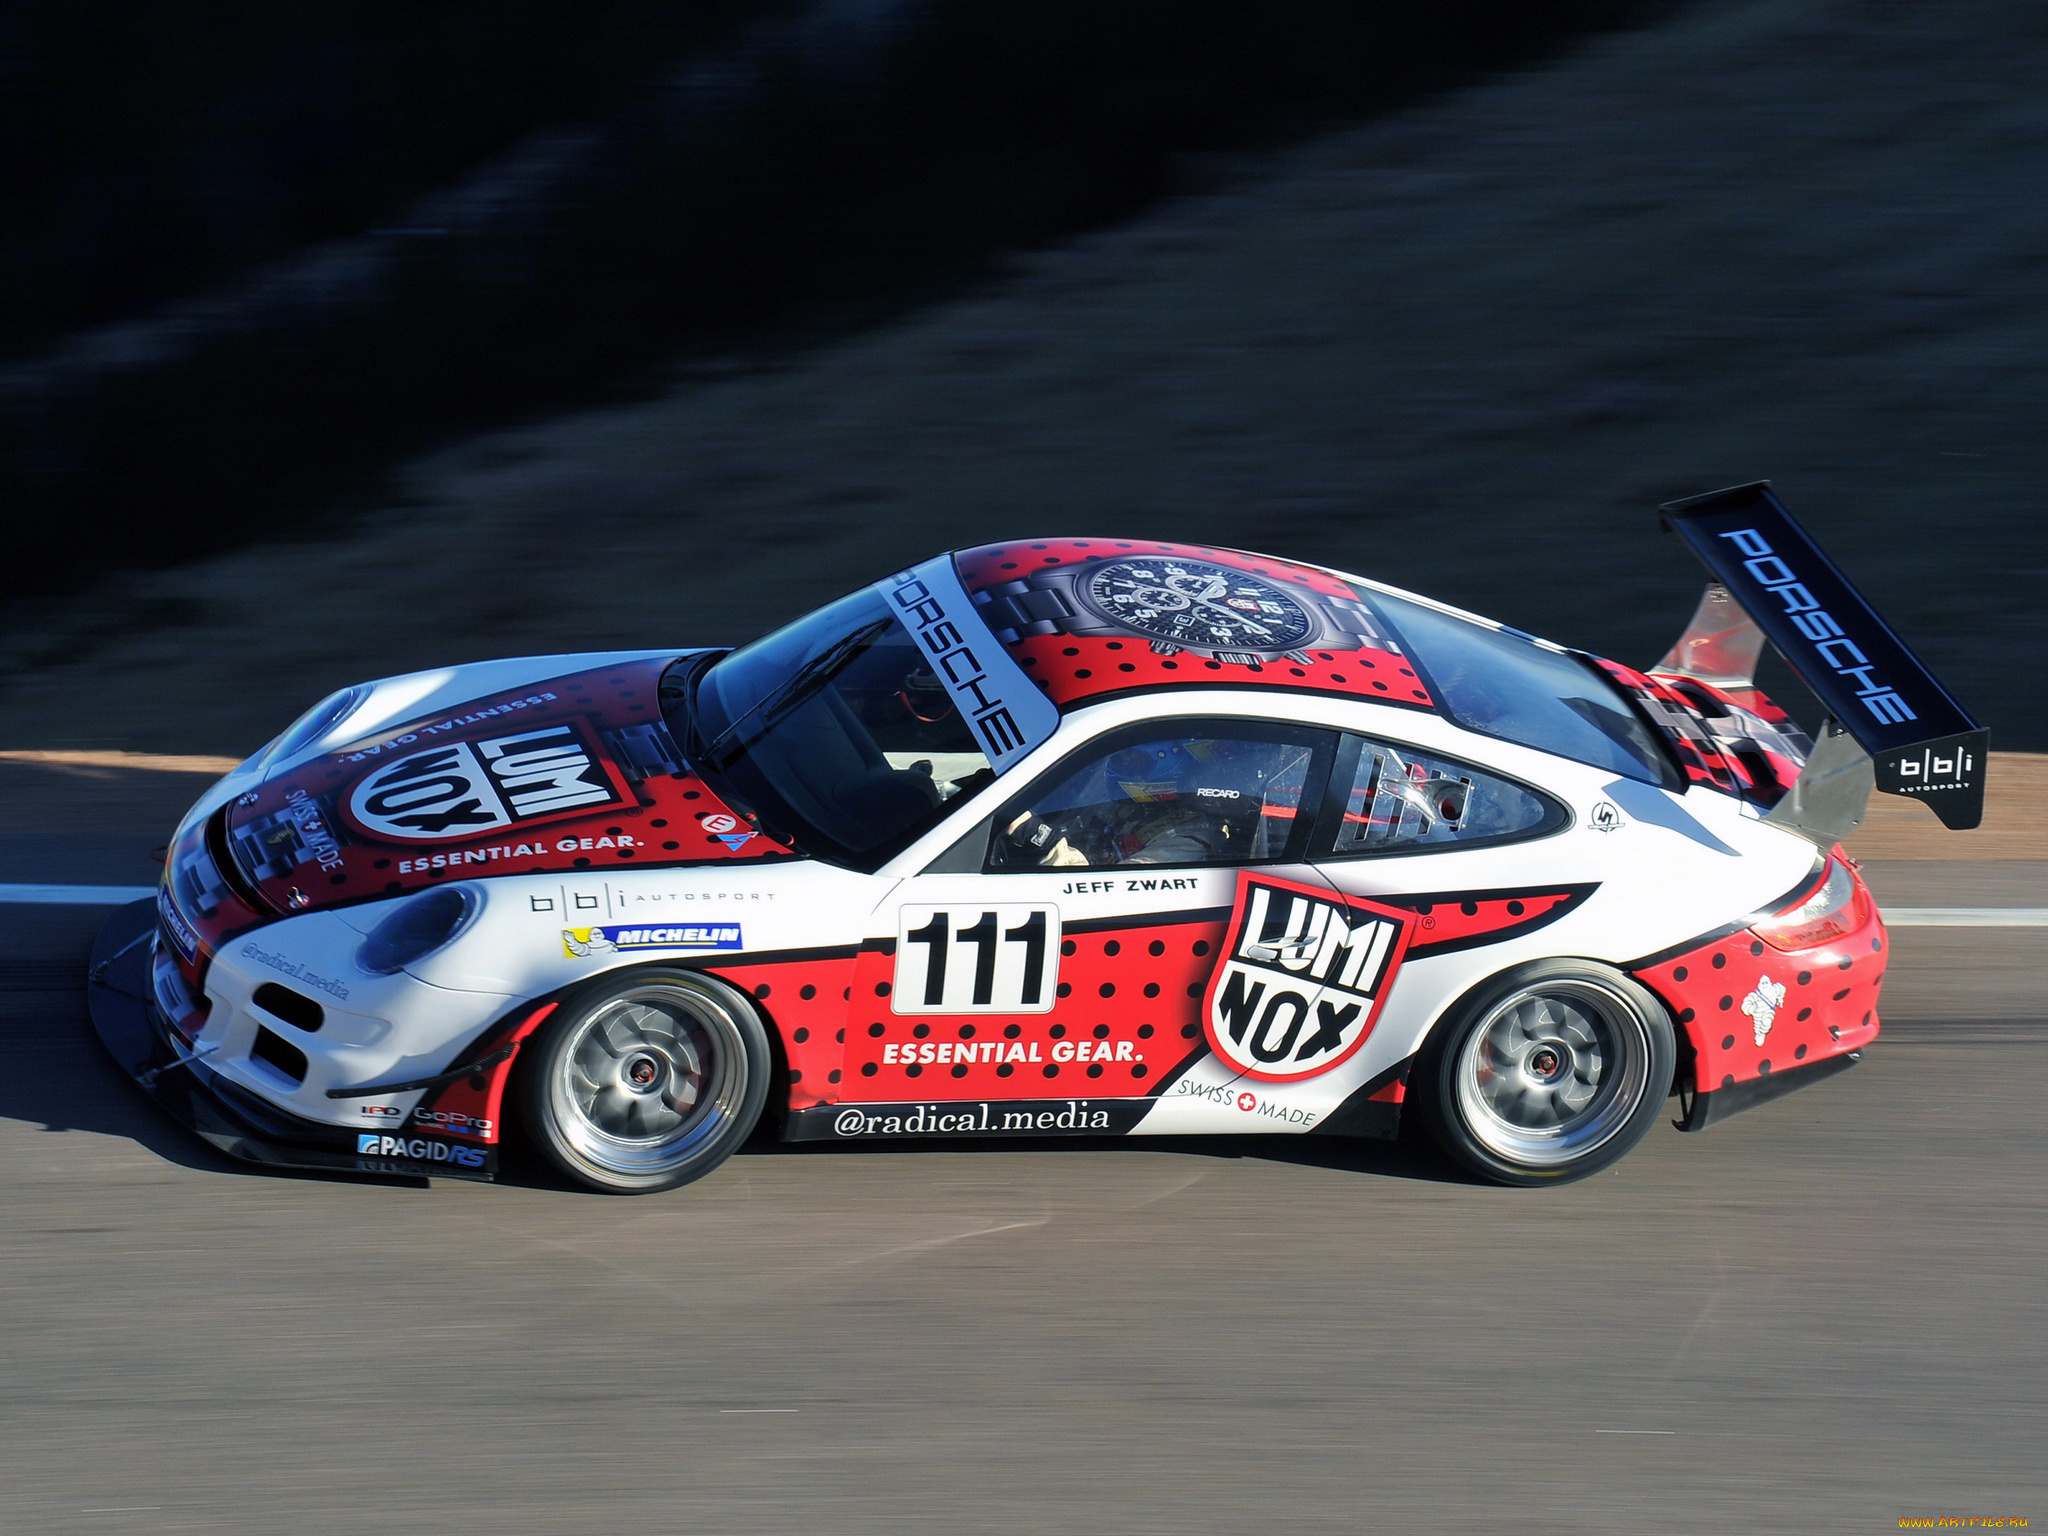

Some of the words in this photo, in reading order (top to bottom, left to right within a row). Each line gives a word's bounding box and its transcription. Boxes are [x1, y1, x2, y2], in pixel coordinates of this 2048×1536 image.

[1718, 528, 1919, 725] PORSCHE
[422, 692, 557, 734] ESSENTIAL
[364, 747, 499, 833] NOX
[477, 725, 612, 817] LUMI
[1899, 782, 1970, 793] AUTOSPORT
[1197, 786, 1240, 799] RECARO
[285, 789, 320, 822] SWISS
[306, 828, 345, 873] MADE
[399, 841, 548, 875] ESSENTIAL
[556, 834, 646, 852] GEAR.
[635, 892, 777, 902] AUTOSPORT
[1063, 881, 1115, 894] JEFF
[1127, 878, 1199, 892] ZWART
[616, 927, 741, 944] MICHELIN
[1239, 886, 1396, 993] LUMI
[907, 910, 1047, 1006] 111
[1218, 969, 1363, 1064] NOX
[883, 1042, 1043, 1065] ESSENTIAL
[1051, 1041, 1144, 1062] GEAR.
[413, 1106, 493, 1130] GoPro
[834, 1101, 1109, 1137] @radical.media
[1178, 1080, 1235, 1106] SWISS
[1257, 1100, 1316, 1126] MADE
